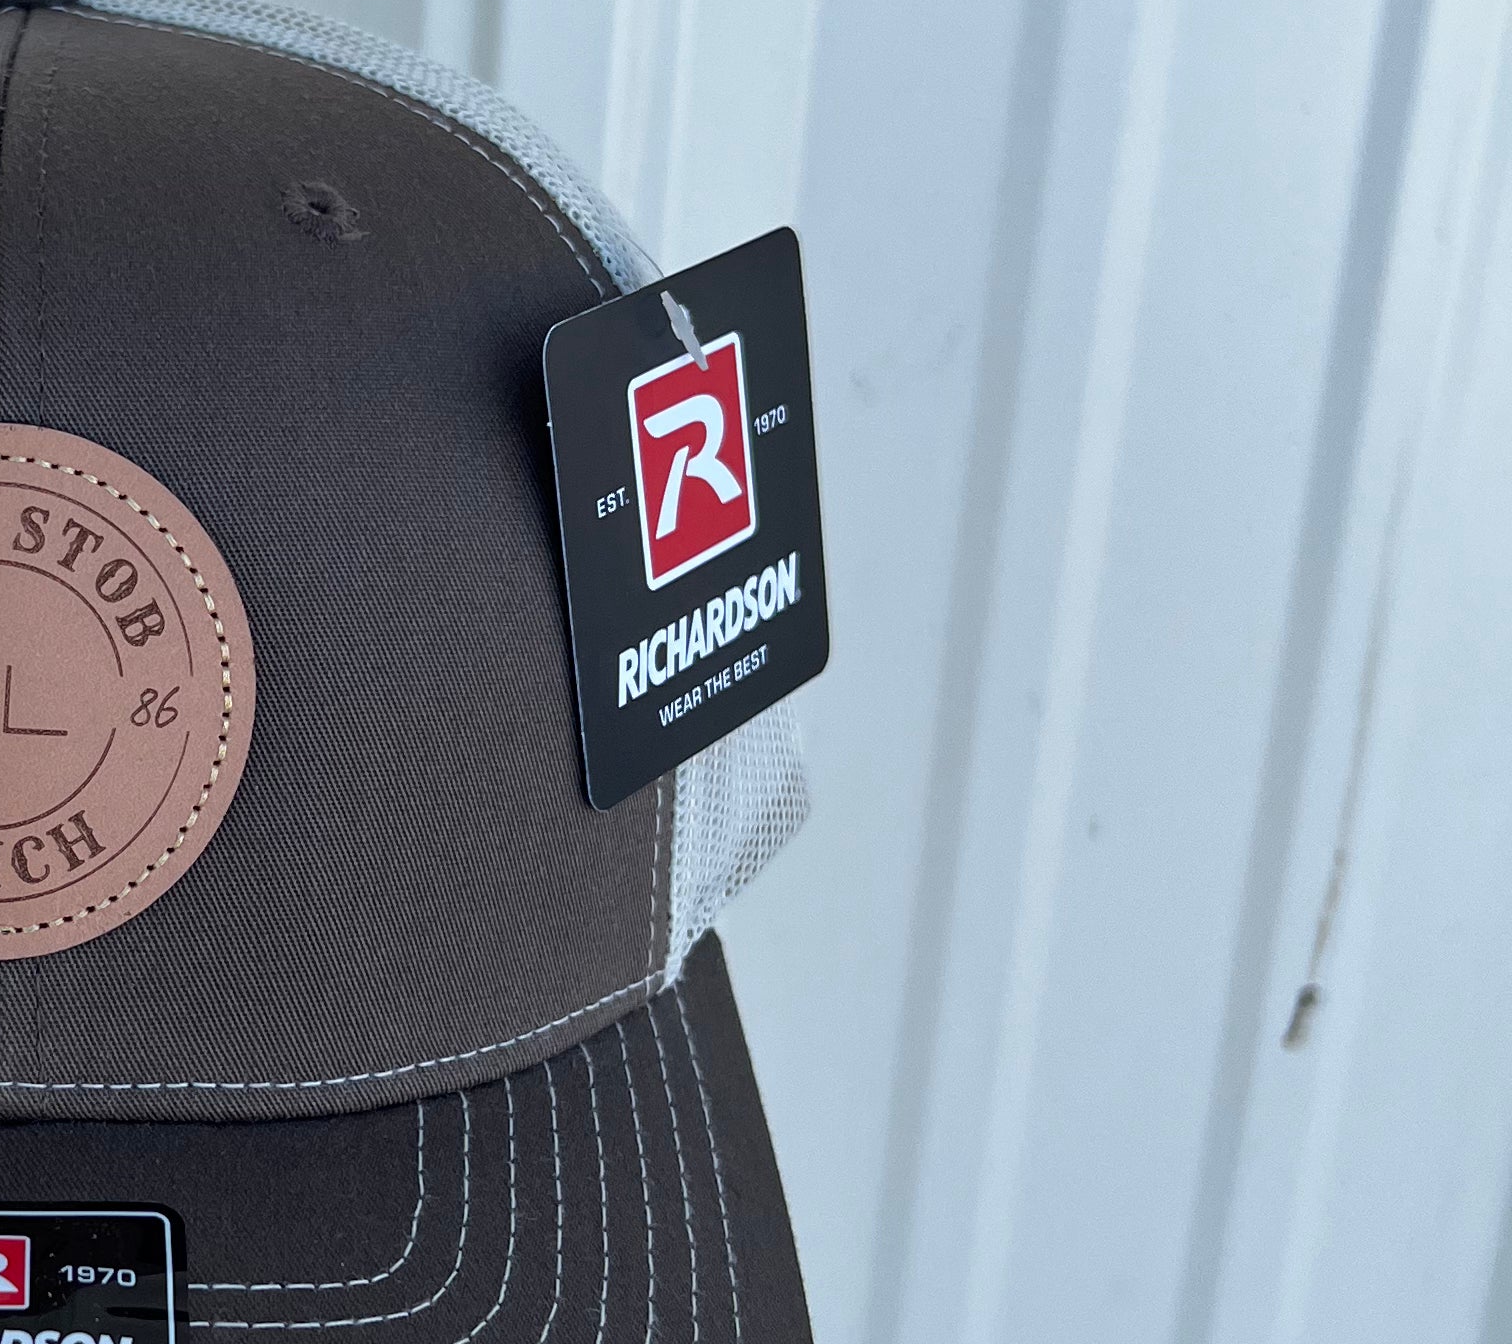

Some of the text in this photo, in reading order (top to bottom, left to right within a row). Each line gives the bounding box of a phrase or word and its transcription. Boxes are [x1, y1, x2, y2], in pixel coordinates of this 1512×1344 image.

[753, 404, 787, 436] 1970
[596, 486, 631, 519] EST.
[12, 505, 167, 648] STOB
[658, 644, 769, 728] WEAR THE BEST
[129, 686, 181, 729] 86
[59, 1264, 137, 1287] 1970
